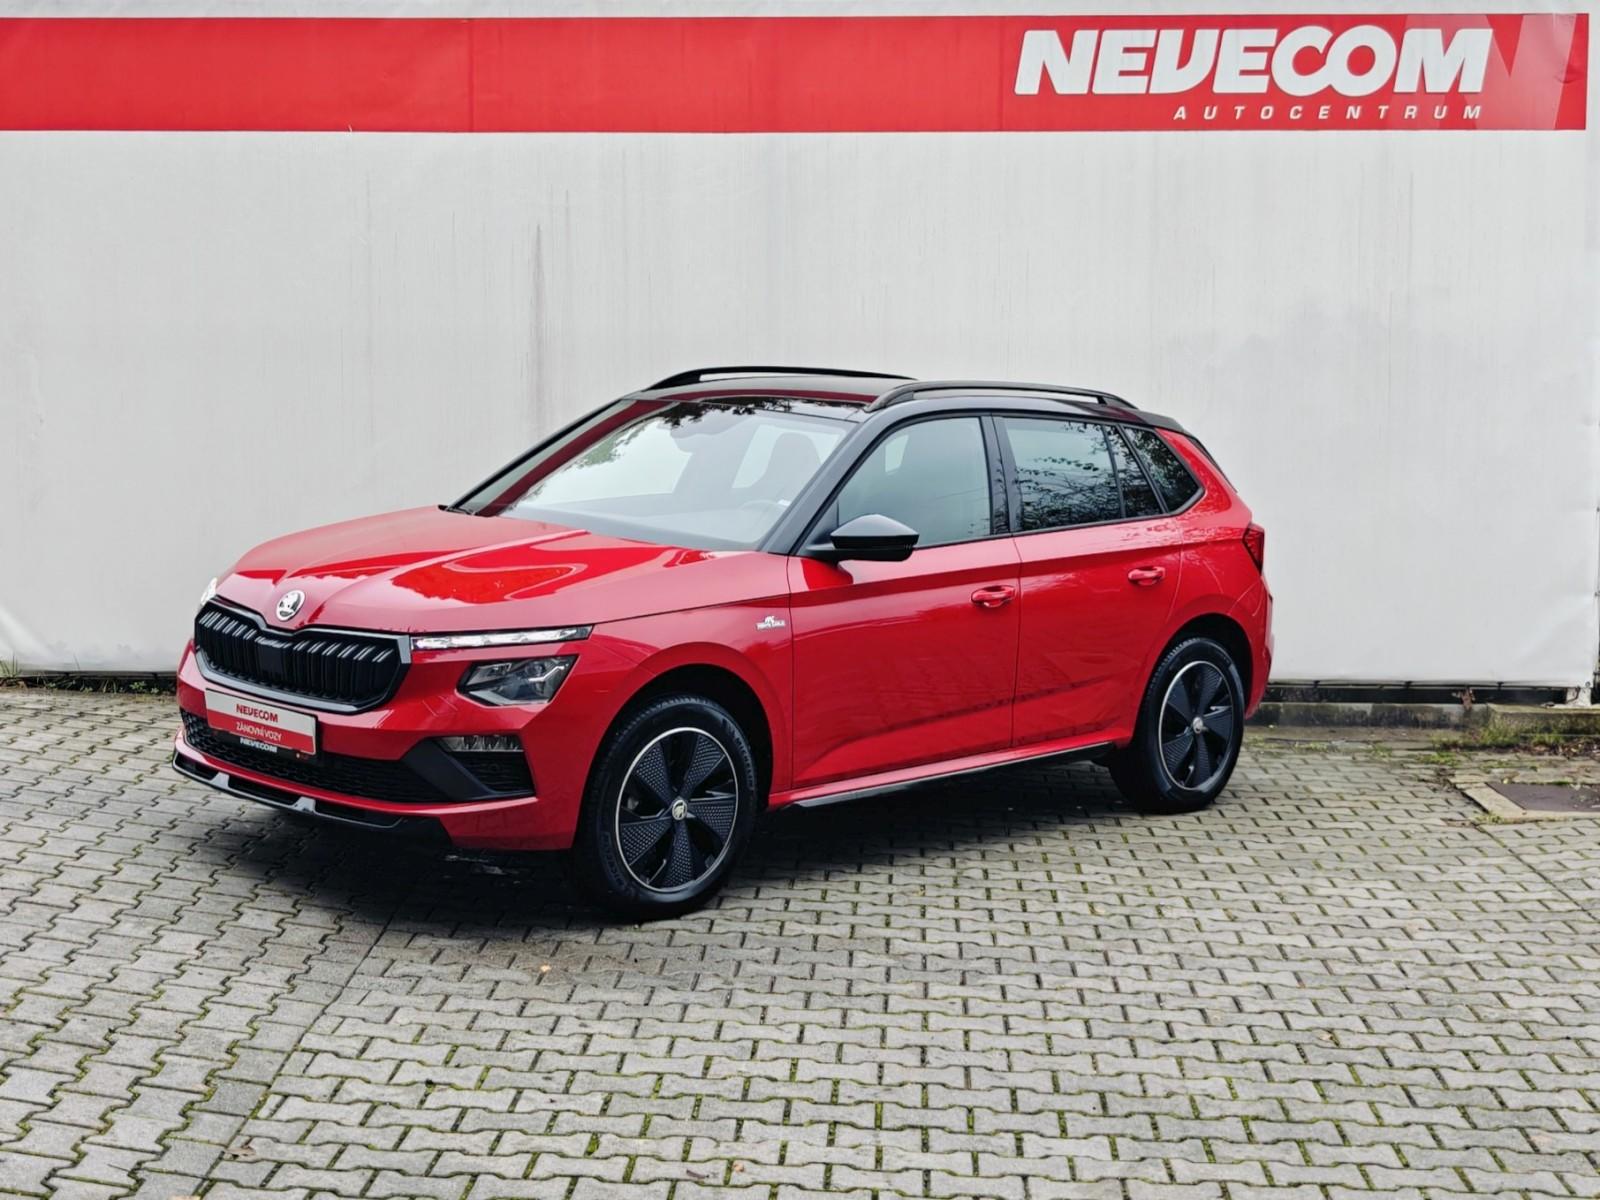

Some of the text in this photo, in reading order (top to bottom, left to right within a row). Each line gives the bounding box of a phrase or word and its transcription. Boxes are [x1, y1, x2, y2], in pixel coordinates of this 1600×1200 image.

[1014, 25, 1494, 97] NEVECOM
[1173, 105, 1483, 121] AUTOCENTRUM
[236, 704, 278, 722] NEVECOM
[265, 730, 282, 741] VOZY
[240, 737, 277, 752] NEVECOM
